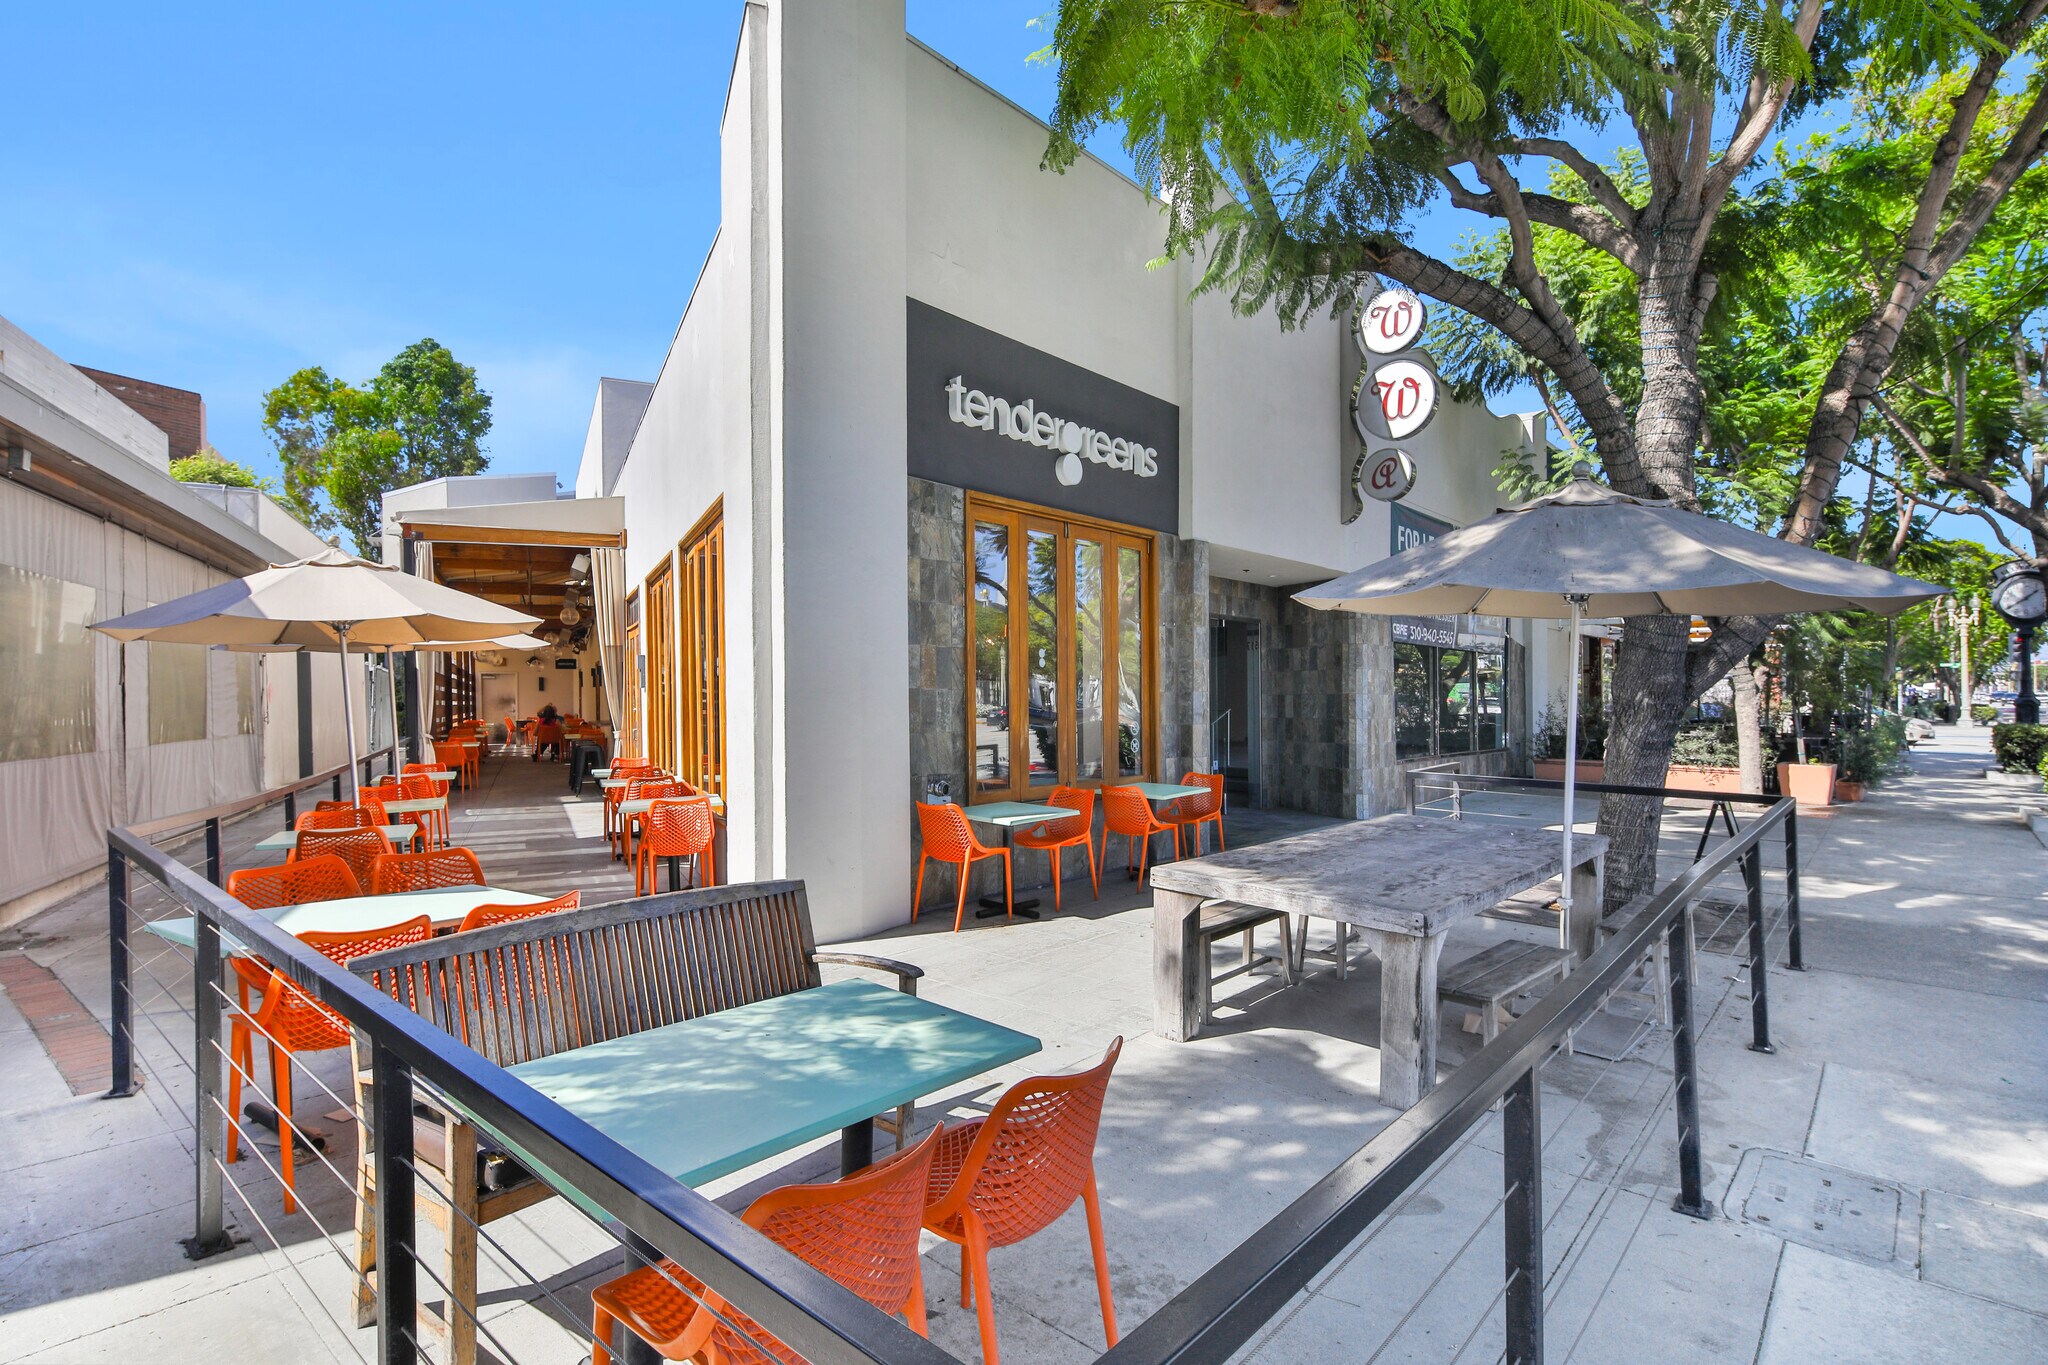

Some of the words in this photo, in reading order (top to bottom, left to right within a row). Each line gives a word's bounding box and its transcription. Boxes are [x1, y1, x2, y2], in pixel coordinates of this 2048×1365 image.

[1371, 301, 1413, 339] W
[1370, 377, 1421, 421] W
[1397, 525, 1420, 550] FOR
